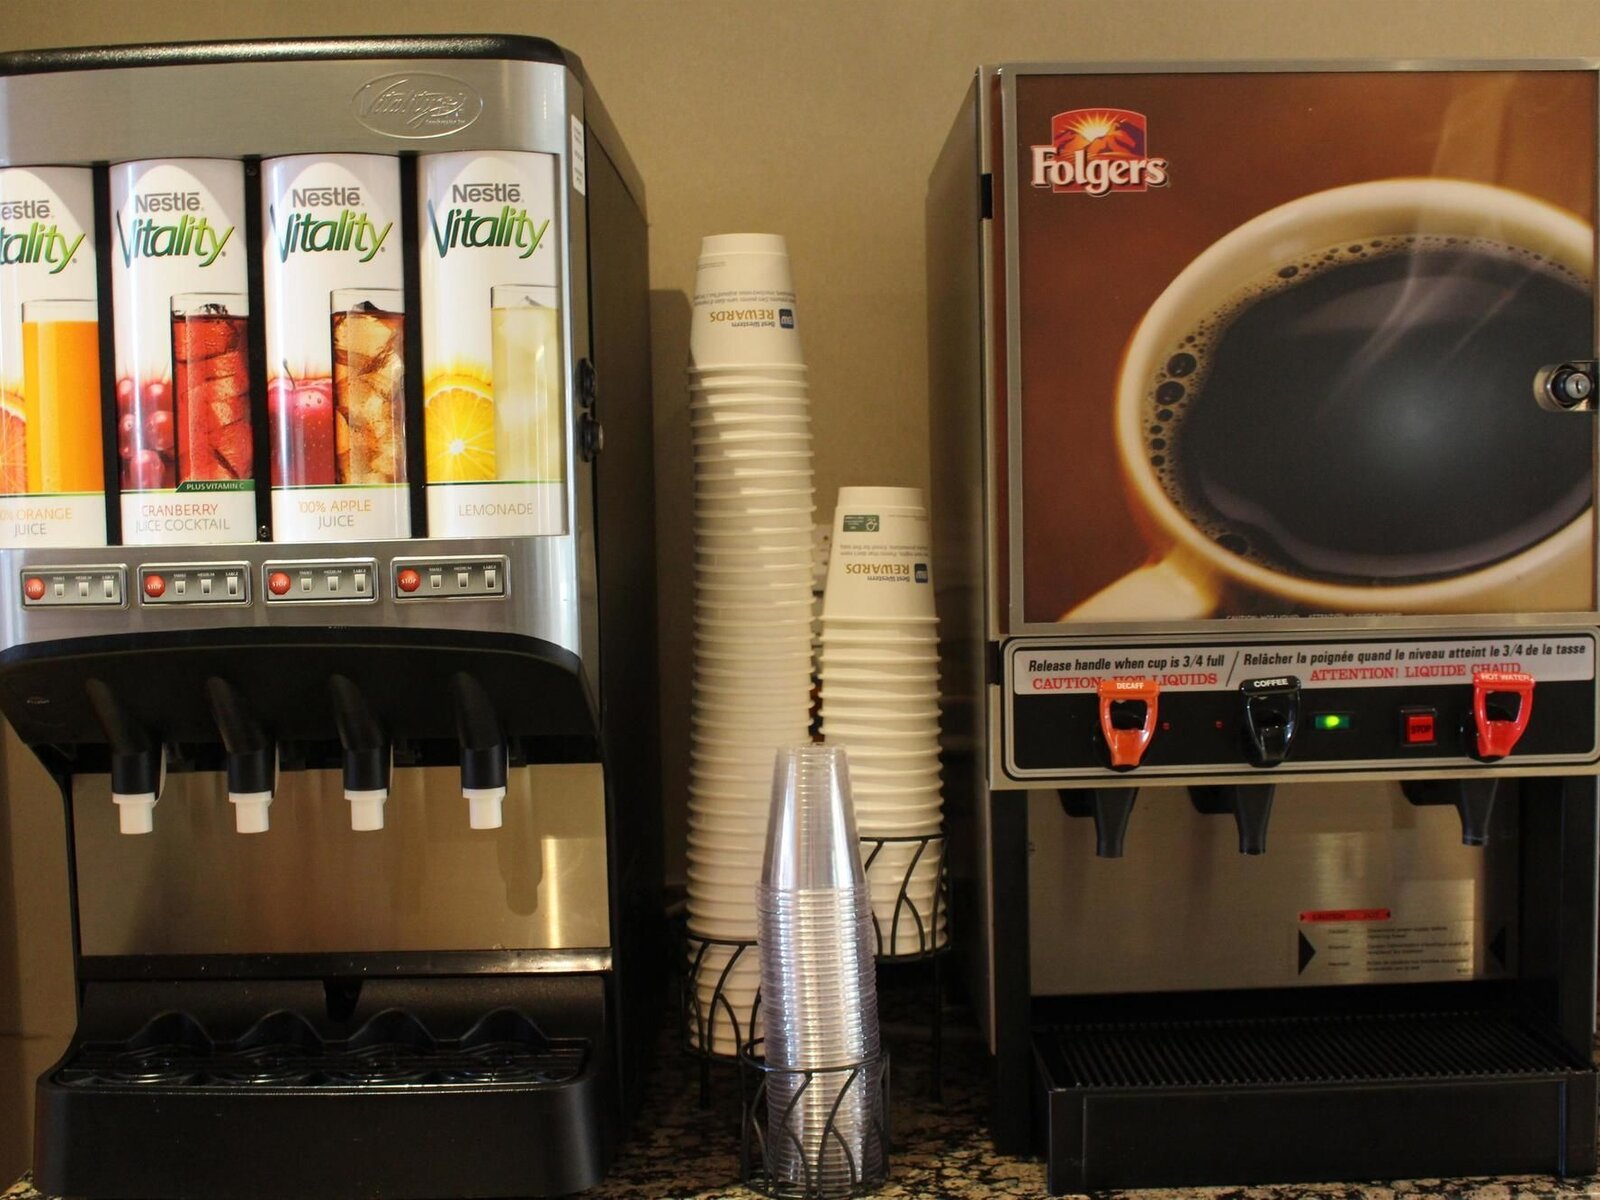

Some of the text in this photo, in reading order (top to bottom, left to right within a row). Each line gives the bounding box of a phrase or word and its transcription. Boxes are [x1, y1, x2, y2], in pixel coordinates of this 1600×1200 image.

[1030, 145, 1170, 197] Folgers
[0, 199, 50, 220] estlé
[270, 203, 393, 264] Vitality
[428, 199, 550, 259] Vitality
[116, 209, 235, 269] Vitality
[0, 221, 86, 275] tality
[710, 309, 774, 323] REWARDS
[186, 483, 205, 491] PLUS
[207, 482, 237, 490] VITAMIN
[141, 503, 219, 517] CRANBERRY
[330, 499, 373, 512] APPLE
[458, 502, 534, 516] LEMONADE
[16, 507, 73, 521] ORANGE
[135, 518, 231, 533] JUICE COCKTAIL
[318, 514, 355, 530] JUICE
[14, 523, 48, 537] JUICE
[846, 563, 910, 574] REWARDS
[1243, 643, 1586, 666] Relâcher la poignée quand le niveau atteint le 3/4 de la tasse
[1029, 654, 1225, 672] Release handle when cup is 3/4 full
[1310, 663, 1521, 681] ATTENTION! LIQUIDE CHAUD
[1501, 673, 1530, 681] WATER
[1116, 682, 1145, 690] DECAFF
[1151, 672, 1218, 687] LIQUIDS
[1253, 678, 1289, 688] COFFEE
[1411, 725, 1431, 734] STOP
